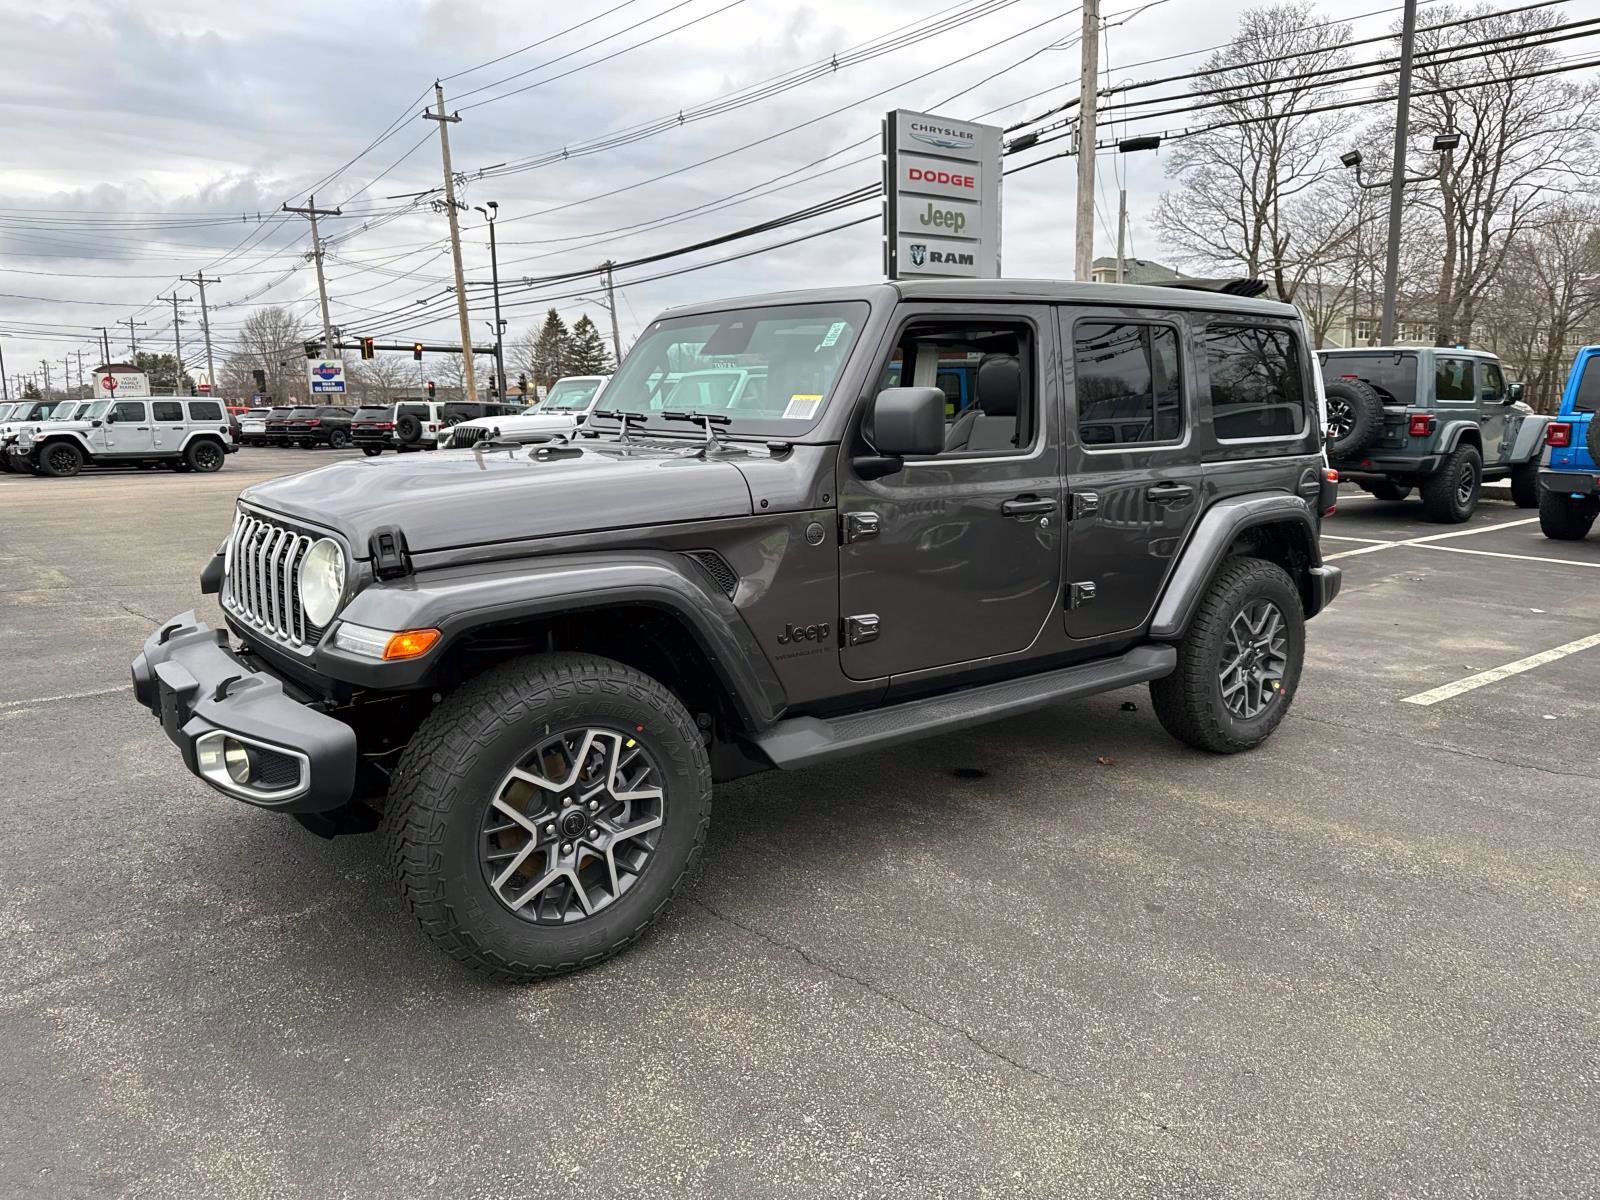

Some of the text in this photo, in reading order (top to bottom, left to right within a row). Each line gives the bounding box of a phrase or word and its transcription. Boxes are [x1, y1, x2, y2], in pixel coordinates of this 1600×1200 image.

[911, 123, 974, 140] CHRYSLER
[909, 168, 975, 189] DODGE
[920, 202, 965, 233] Jeep
[929, 251, 974, 266] RAM
[776, 622, 830, 645] Jeep
